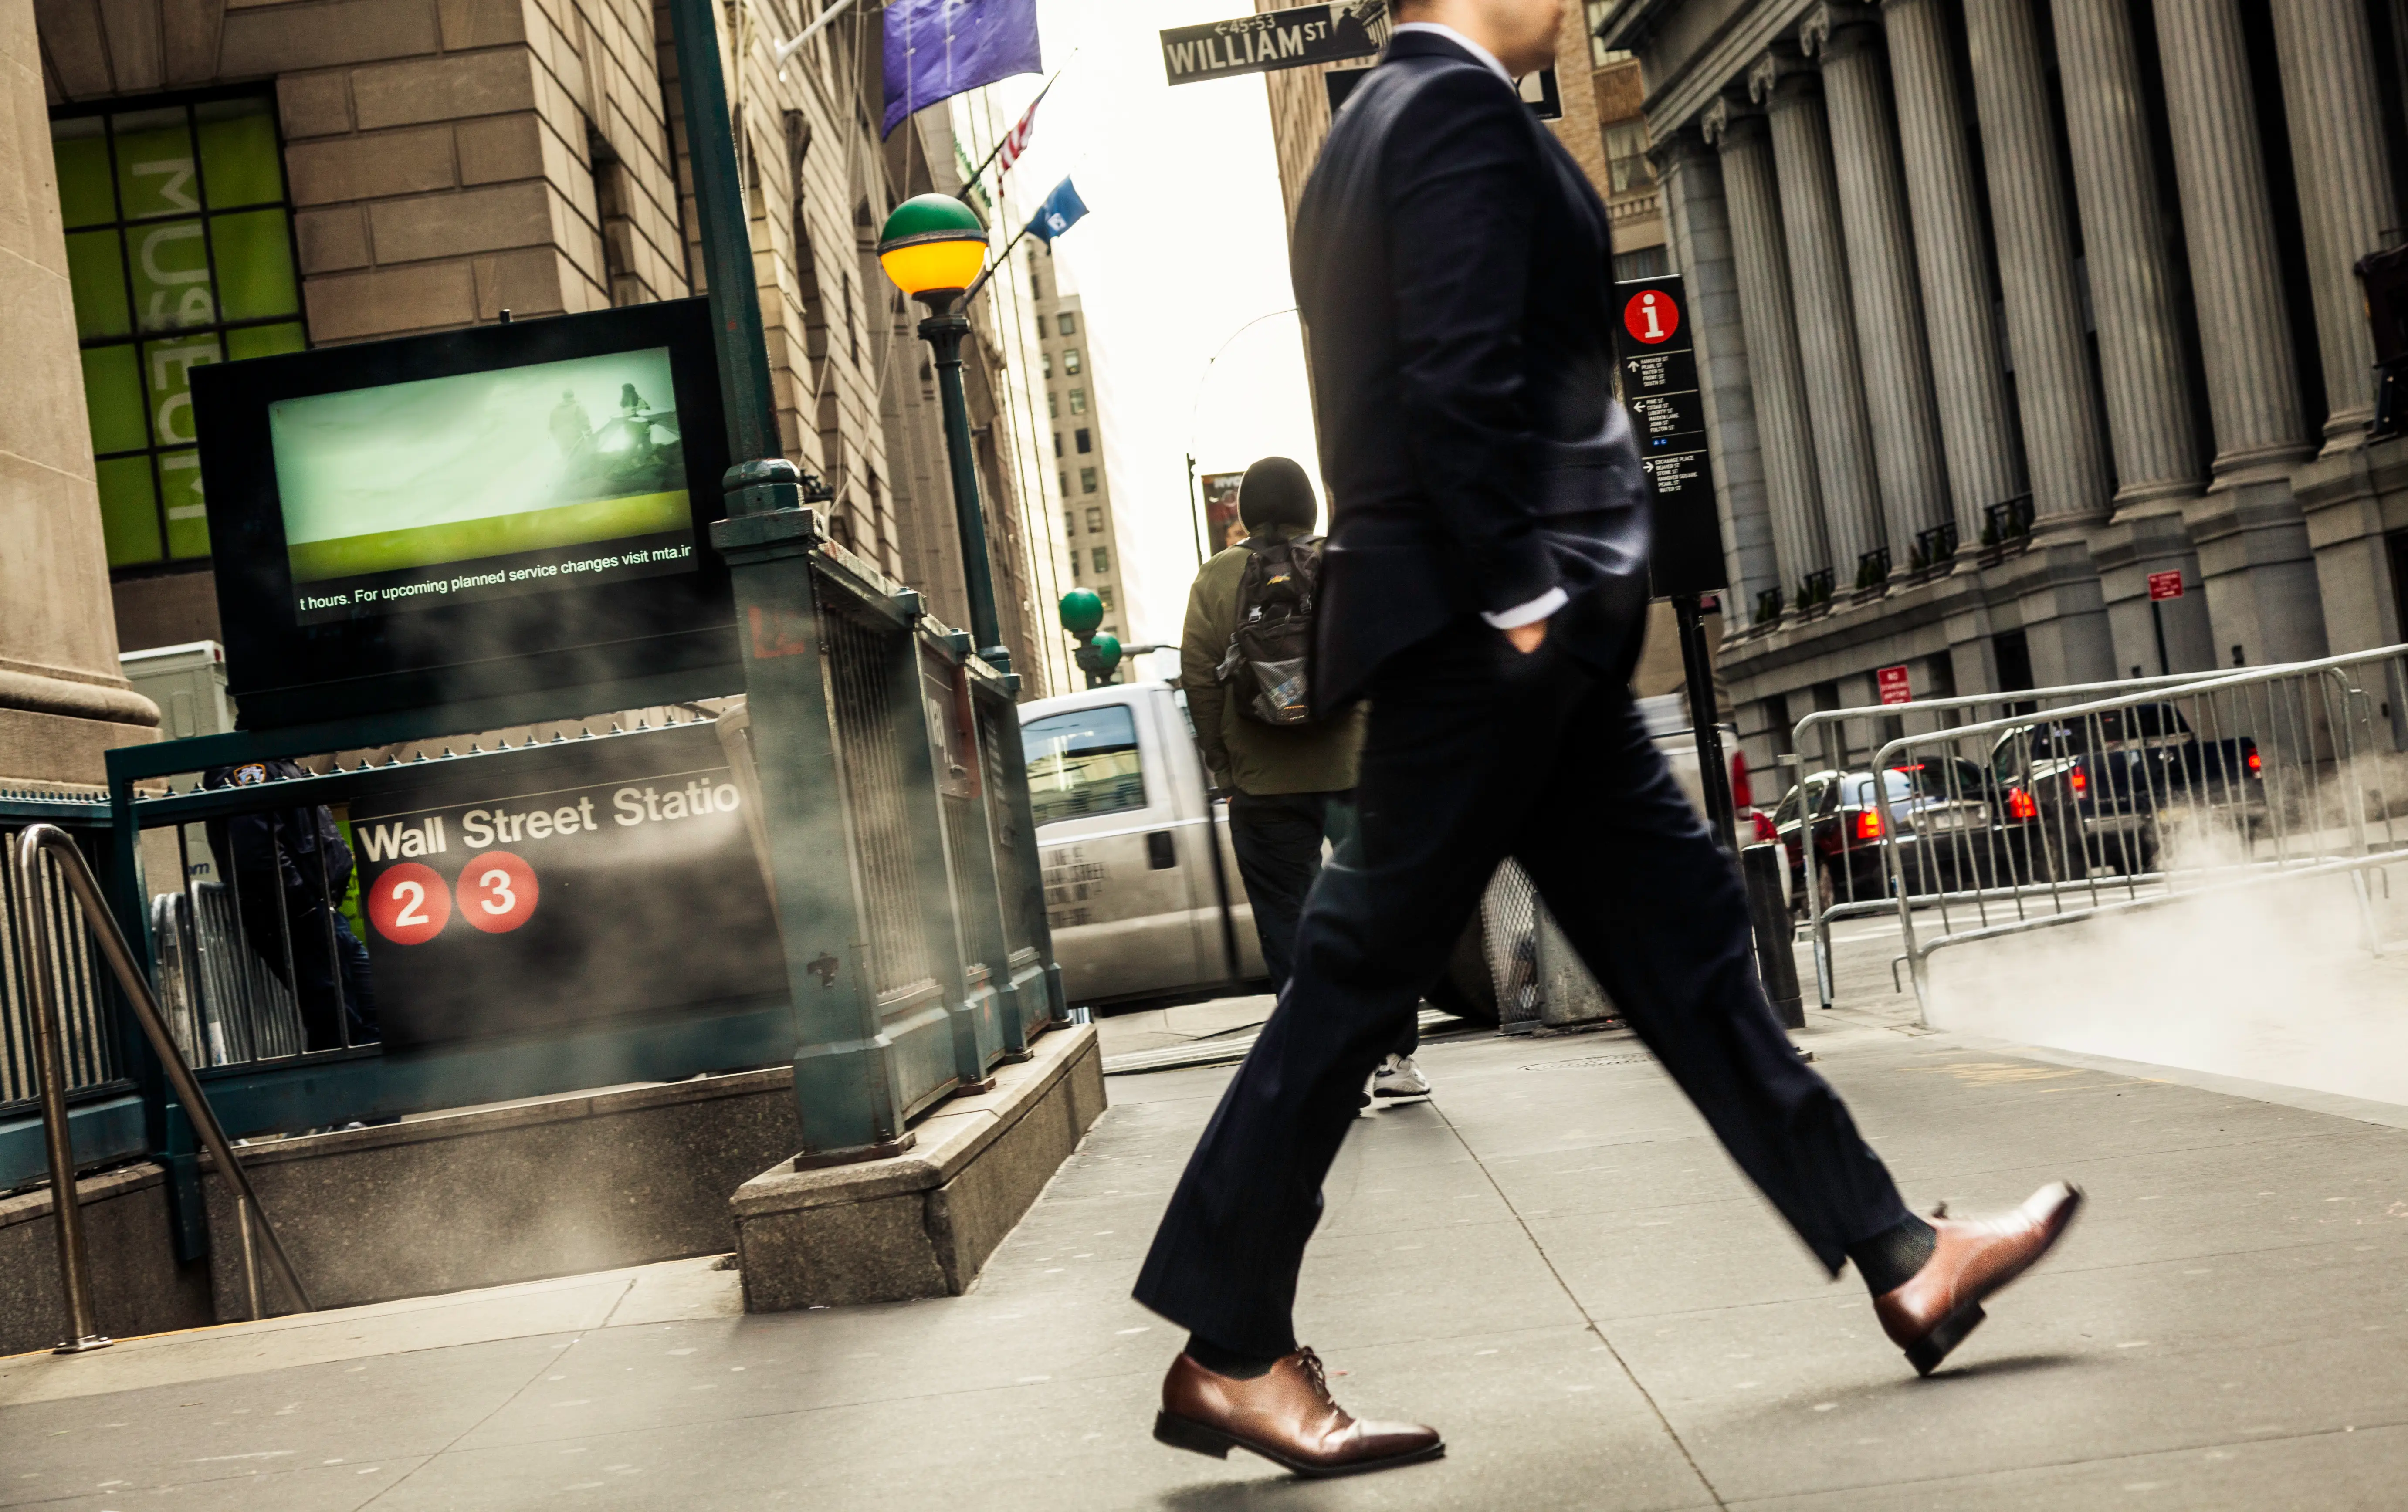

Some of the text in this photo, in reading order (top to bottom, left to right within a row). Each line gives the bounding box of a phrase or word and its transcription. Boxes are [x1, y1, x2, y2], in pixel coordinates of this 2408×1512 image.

[1166, 21, 1327, 75] WILLIAM ST
[1229, 14, 1276, 34] 45-53
[308, 595, 351, 609] hours.
[354, 589, 378, 602] For
[382, 580, 447, 600] upcoming
[451, 570, 505, 592] planned
[509, 565, 558, 581] service
[561, 557, 619, 572] changes
[621, 550, 649, 565] visit
[357, 777, 741, 862] Wall Street Statio
[391, 881, 429, 927] 2
[479, 869, 516, 915] 3
